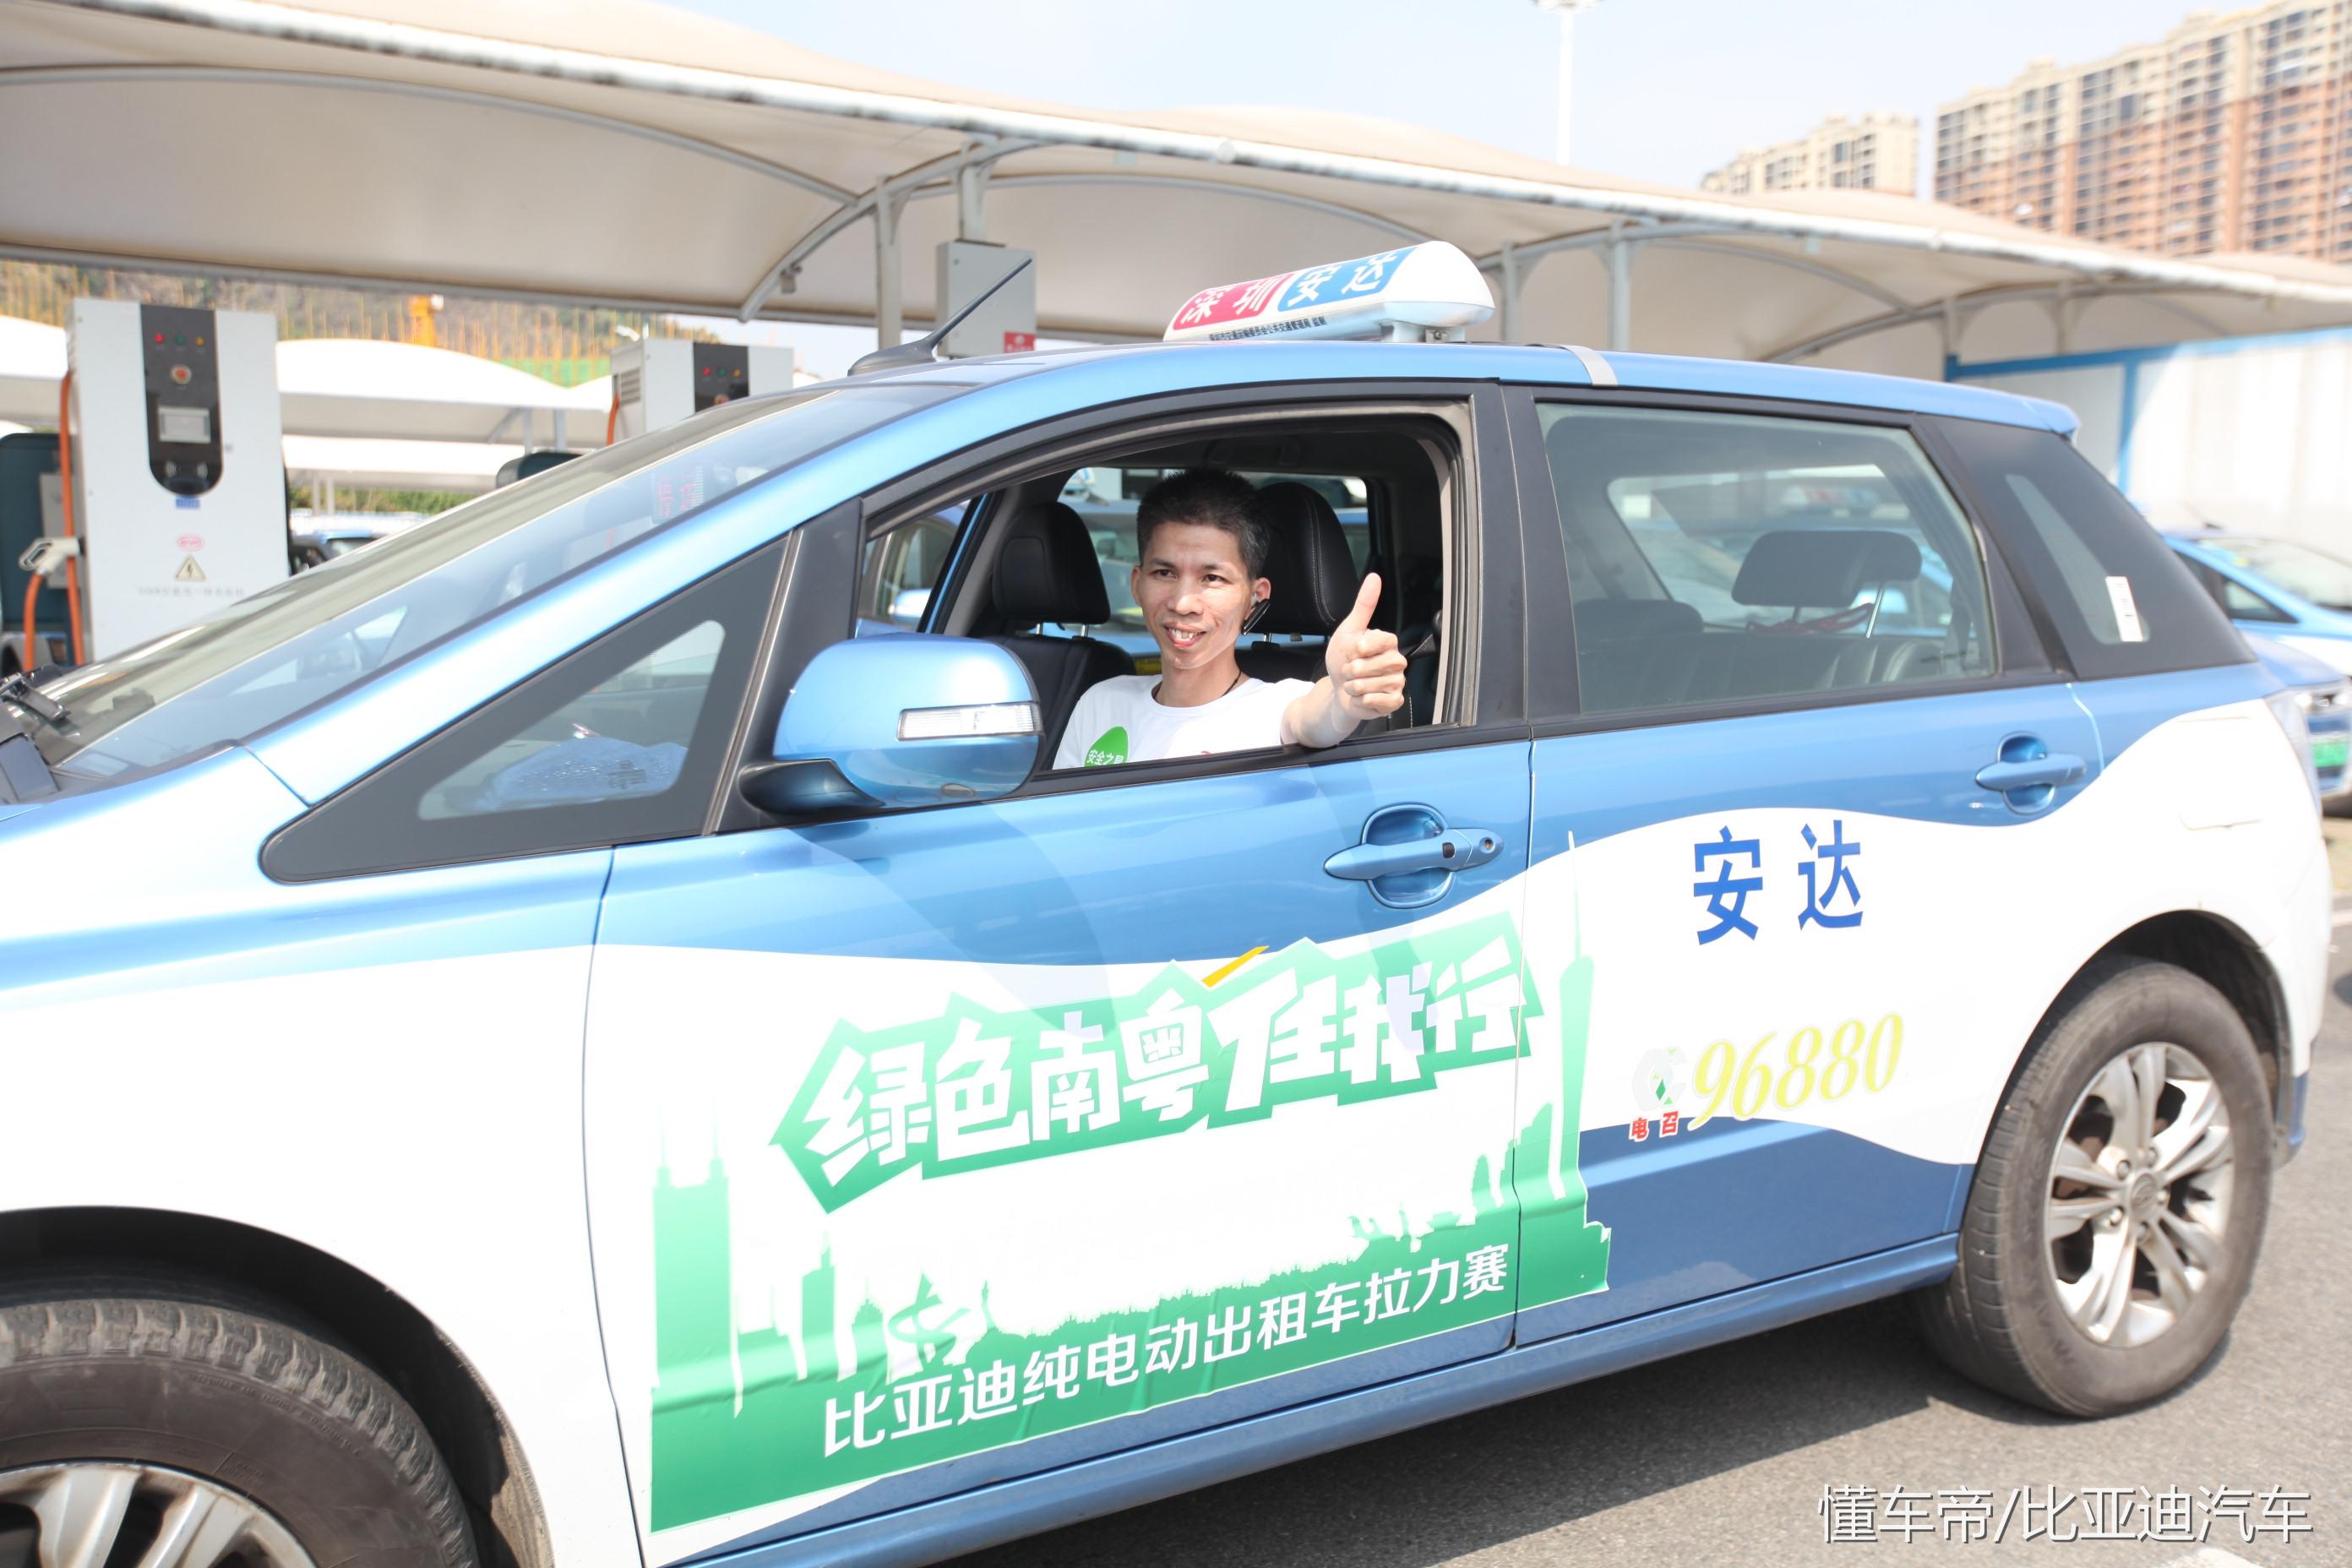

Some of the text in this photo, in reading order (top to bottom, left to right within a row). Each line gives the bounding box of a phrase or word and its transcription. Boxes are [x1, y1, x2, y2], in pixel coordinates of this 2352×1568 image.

[1184, 253, 1398, 324] 深圳 安达
[1693, 819, 1864, 945] 安达
[1630, 1110, 1680, 1141] 电召
[1688, 1012, 1904, 1130] 96880
[824, 1243, 1511, 1458] 比亚迪纯电动出租车拉力赛
